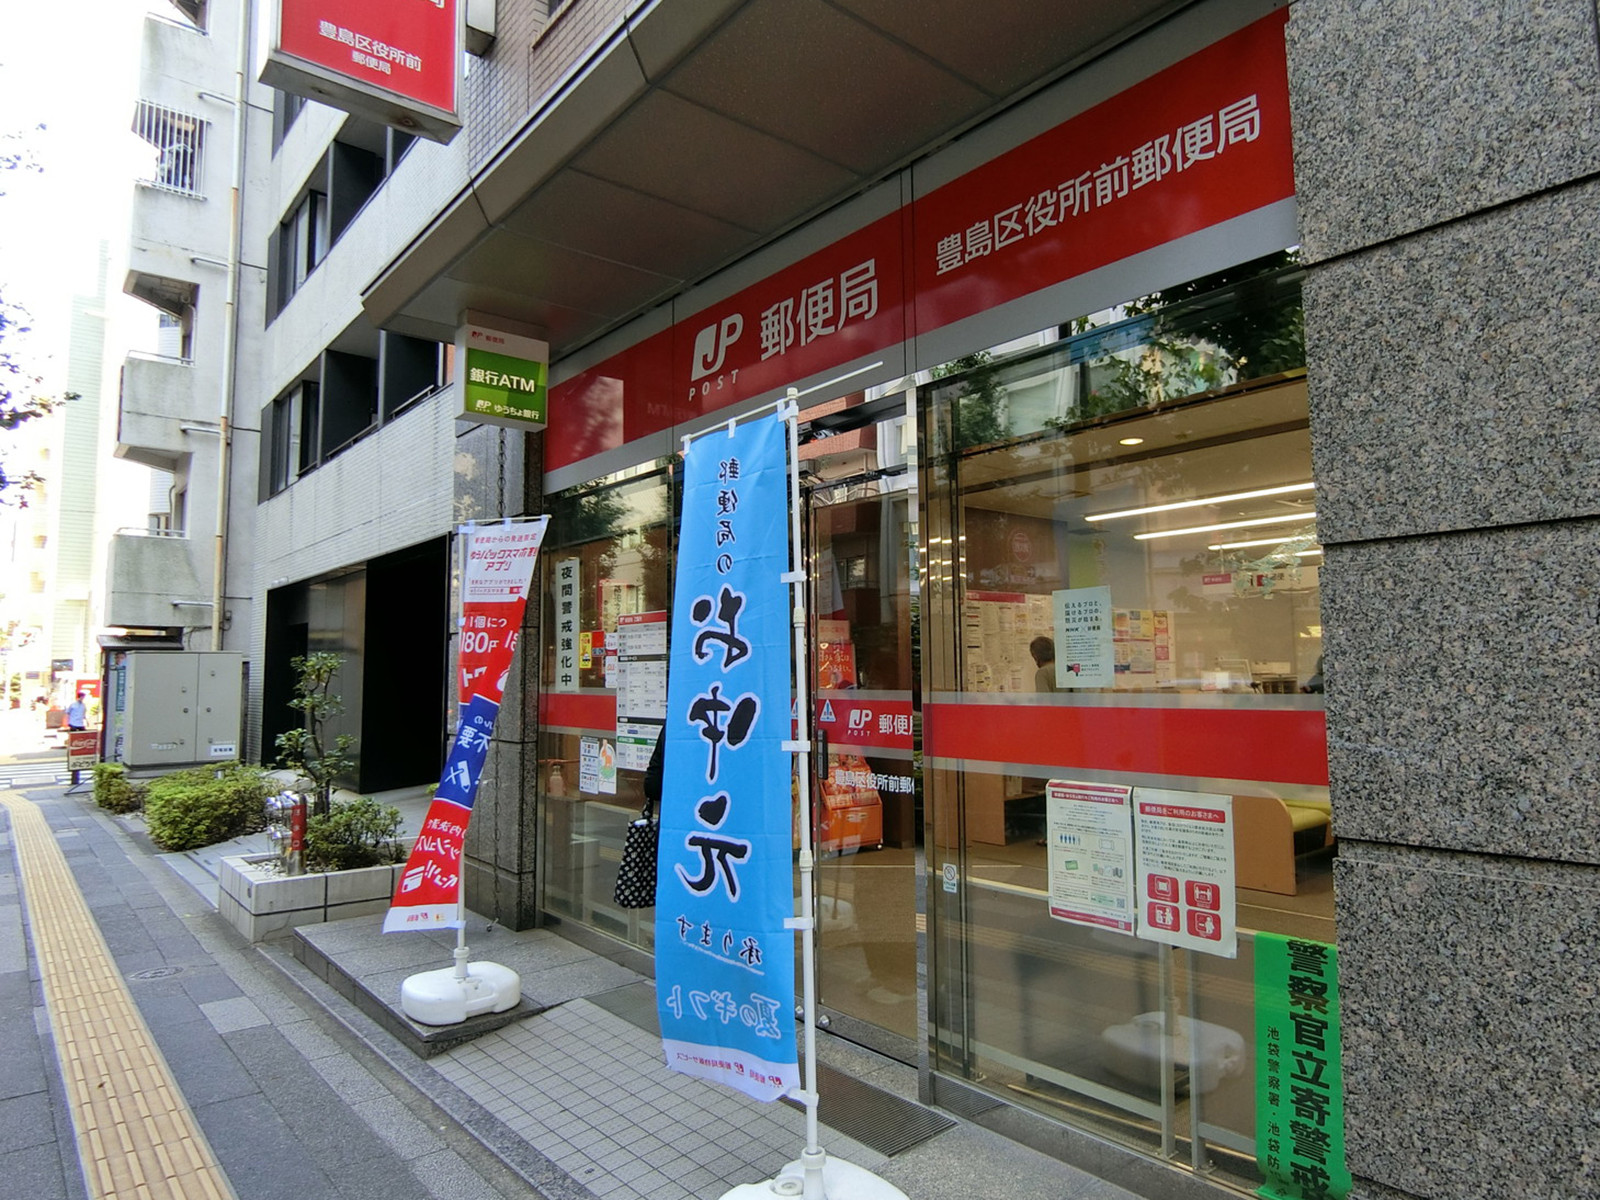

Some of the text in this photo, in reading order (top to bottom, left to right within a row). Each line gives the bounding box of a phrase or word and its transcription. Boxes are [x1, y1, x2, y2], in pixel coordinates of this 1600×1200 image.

[319, 20, 422, 72] 豊島区役所前
[351, 50, 391, 75] 郵便局
[935, 93, 1261, 277] 豊島区役所前郵便局
[759, 258, 879, 361] 郵便局
[470, 367, 536, 393] 銀行ATM
[688, 369, 738, 402] POST
[494, 404, 540, 420] ゆうちょ銀行
[484, 559, 512, 572] アプリ
[560, 566, 573, 687] 夜間警戒強化中
[1287, 938, 1332, 1199] 警察官立寄警戒
